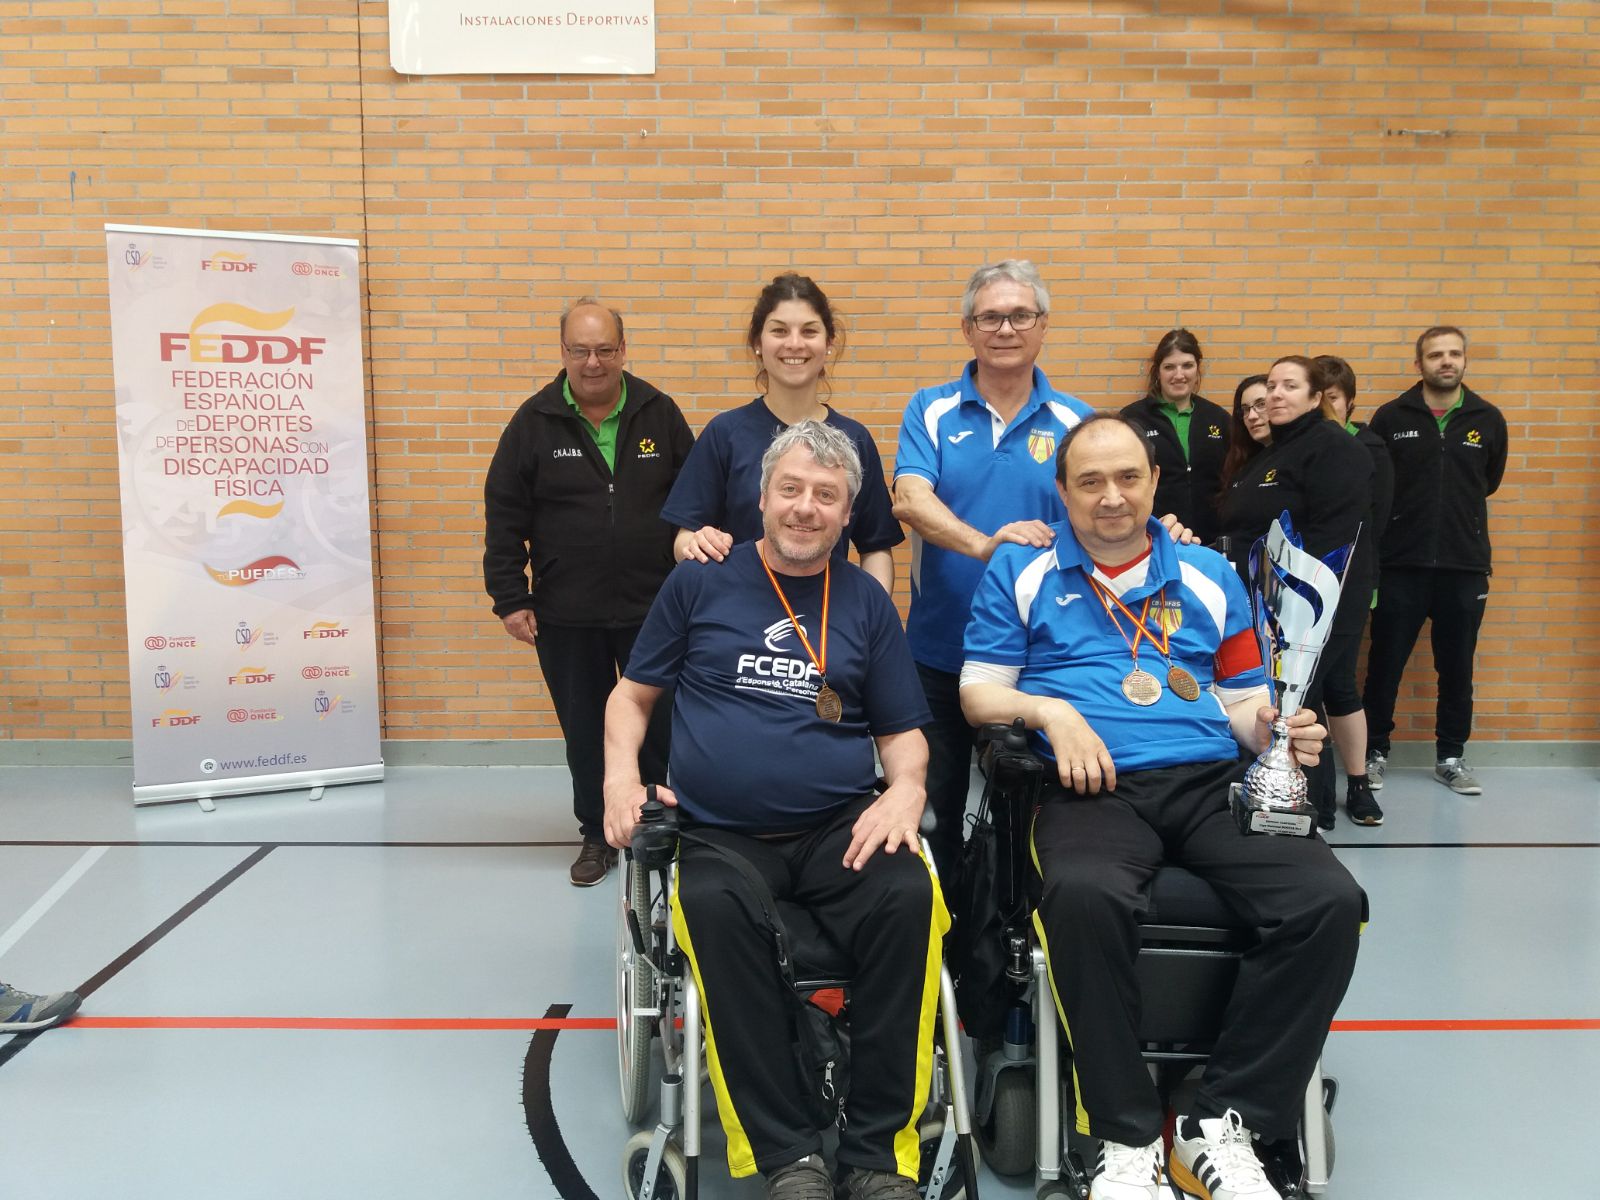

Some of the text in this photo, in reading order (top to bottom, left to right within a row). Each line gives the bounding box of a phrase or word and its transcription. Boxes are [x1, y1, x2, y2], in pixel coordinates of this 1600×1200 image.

[125, 250, 141, 265] CSD
[201, 260, 258, 273] FEDDF
[314, 268, 340, 277] ONCE
[159, 332, 326, 365] FEDDF
[171, 368, 313, 390] FEDERACIÓN
[183, 389, 305, 410] ESPAÑOLA
[164, 457, 329, 475] DISCAPACIDAD
[214, 476, 285, 497] FÍSICA
[235, 628, 251, 644] CSD
[303, 629, 350, 639] FEDDF
[169, 640, 196, 648] ONCE
[154, 672, 171, 688] CSD
[228, 674, 276, 685] FEDDF
[314, 697, 330, 713] CSD
[152, 715, 202, 727] FEDDF
[220, 753, 308, 770] www.feddf.es
